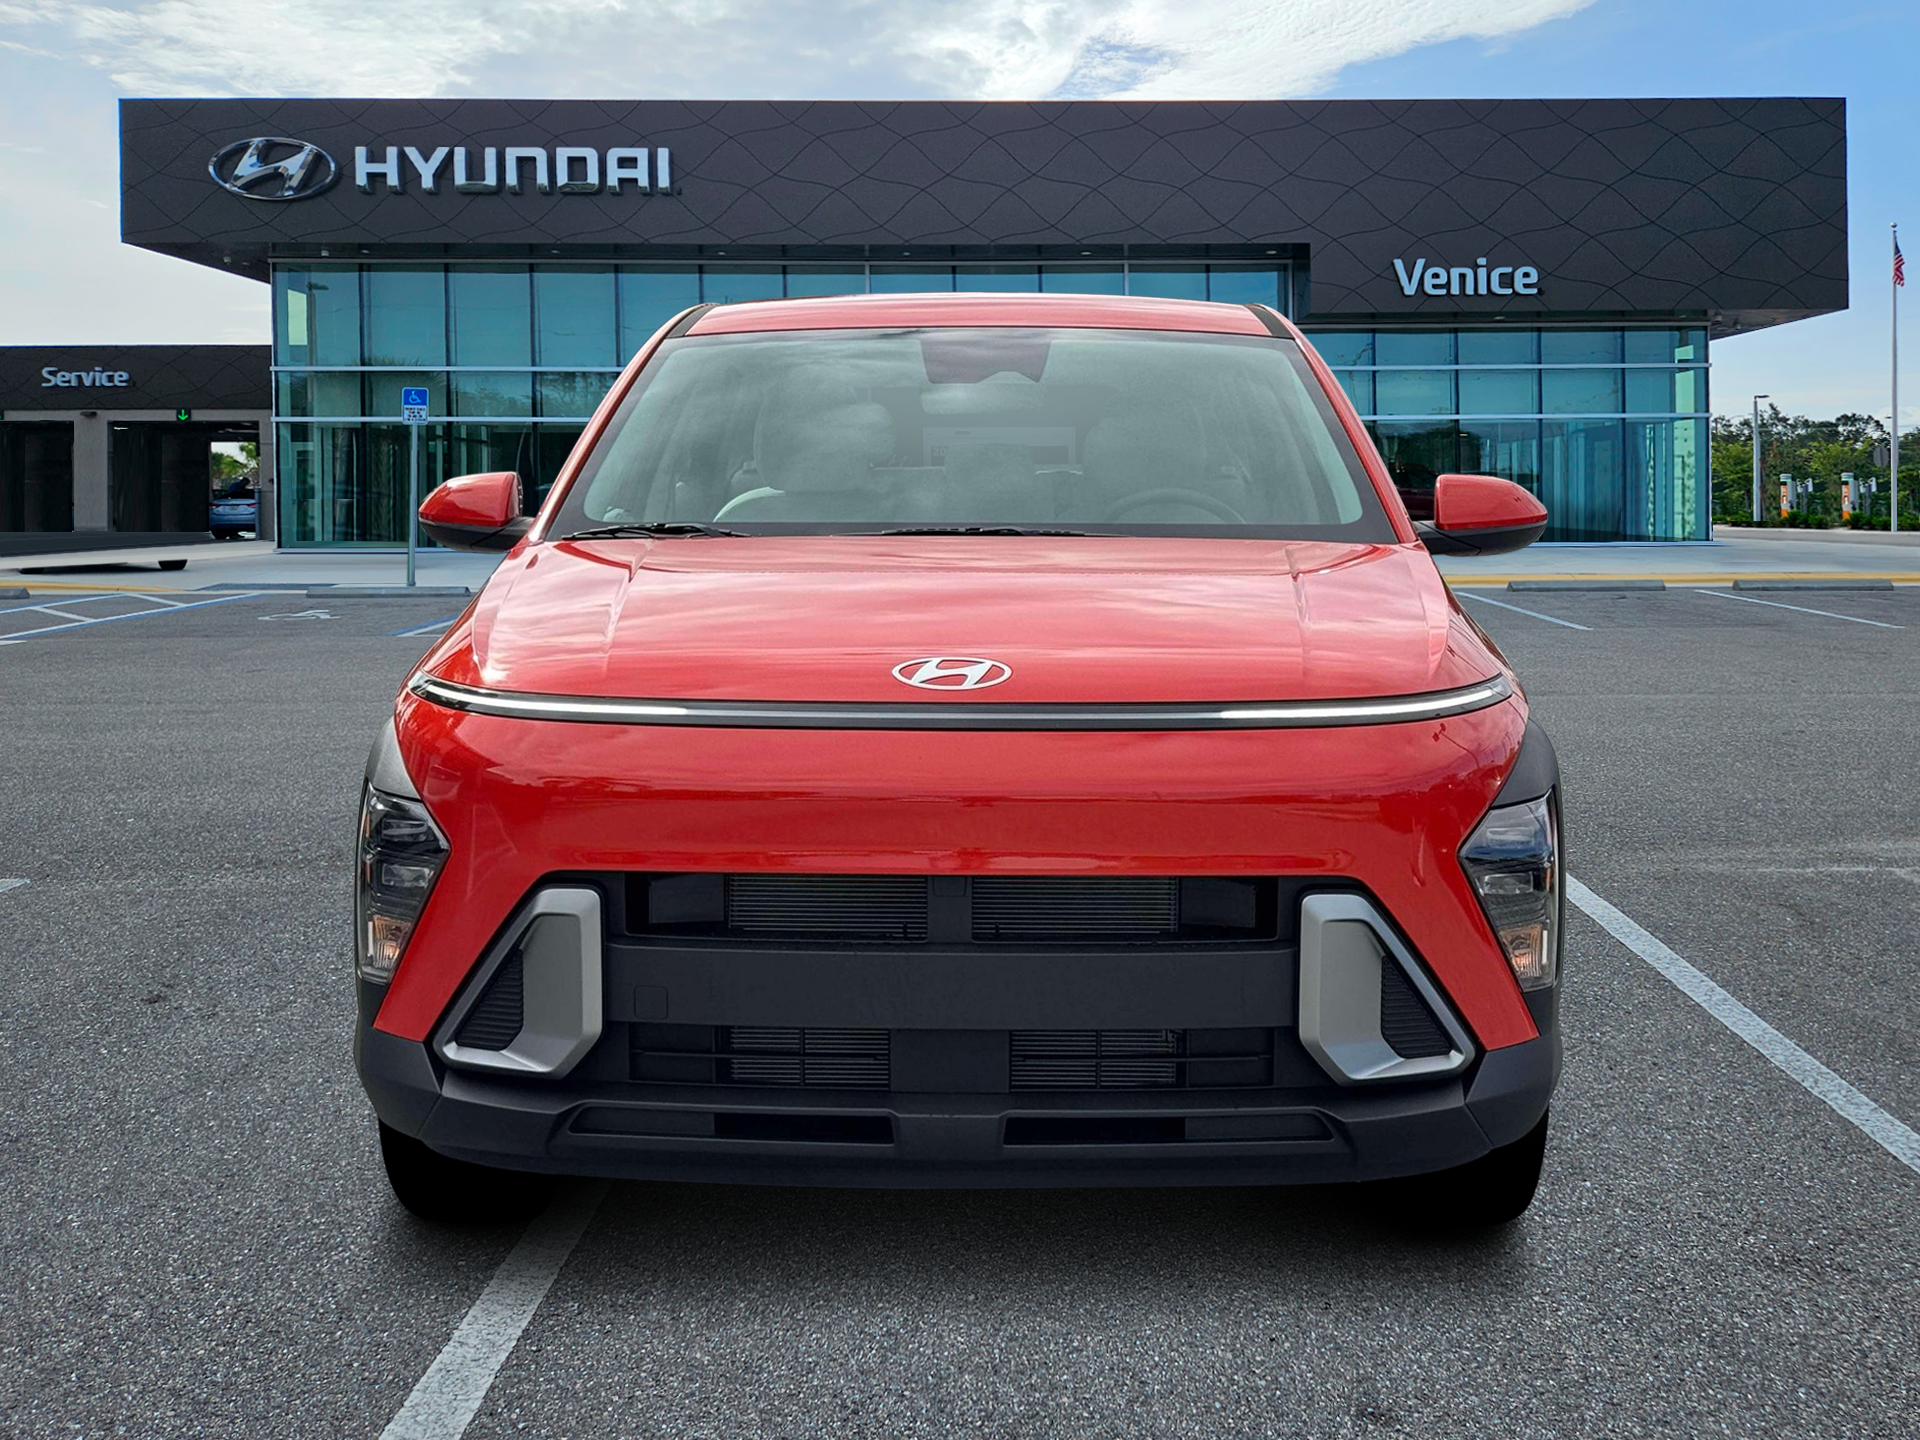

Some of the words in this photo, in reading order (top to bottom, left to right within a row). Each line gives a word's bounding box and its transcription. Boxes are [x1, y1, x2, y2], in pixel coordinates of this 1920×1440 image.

[355, 146, 673, 195] HYUNDAI
[1393, 257, 1539, 296] Venice
[41, 366, 130, 388] Service
